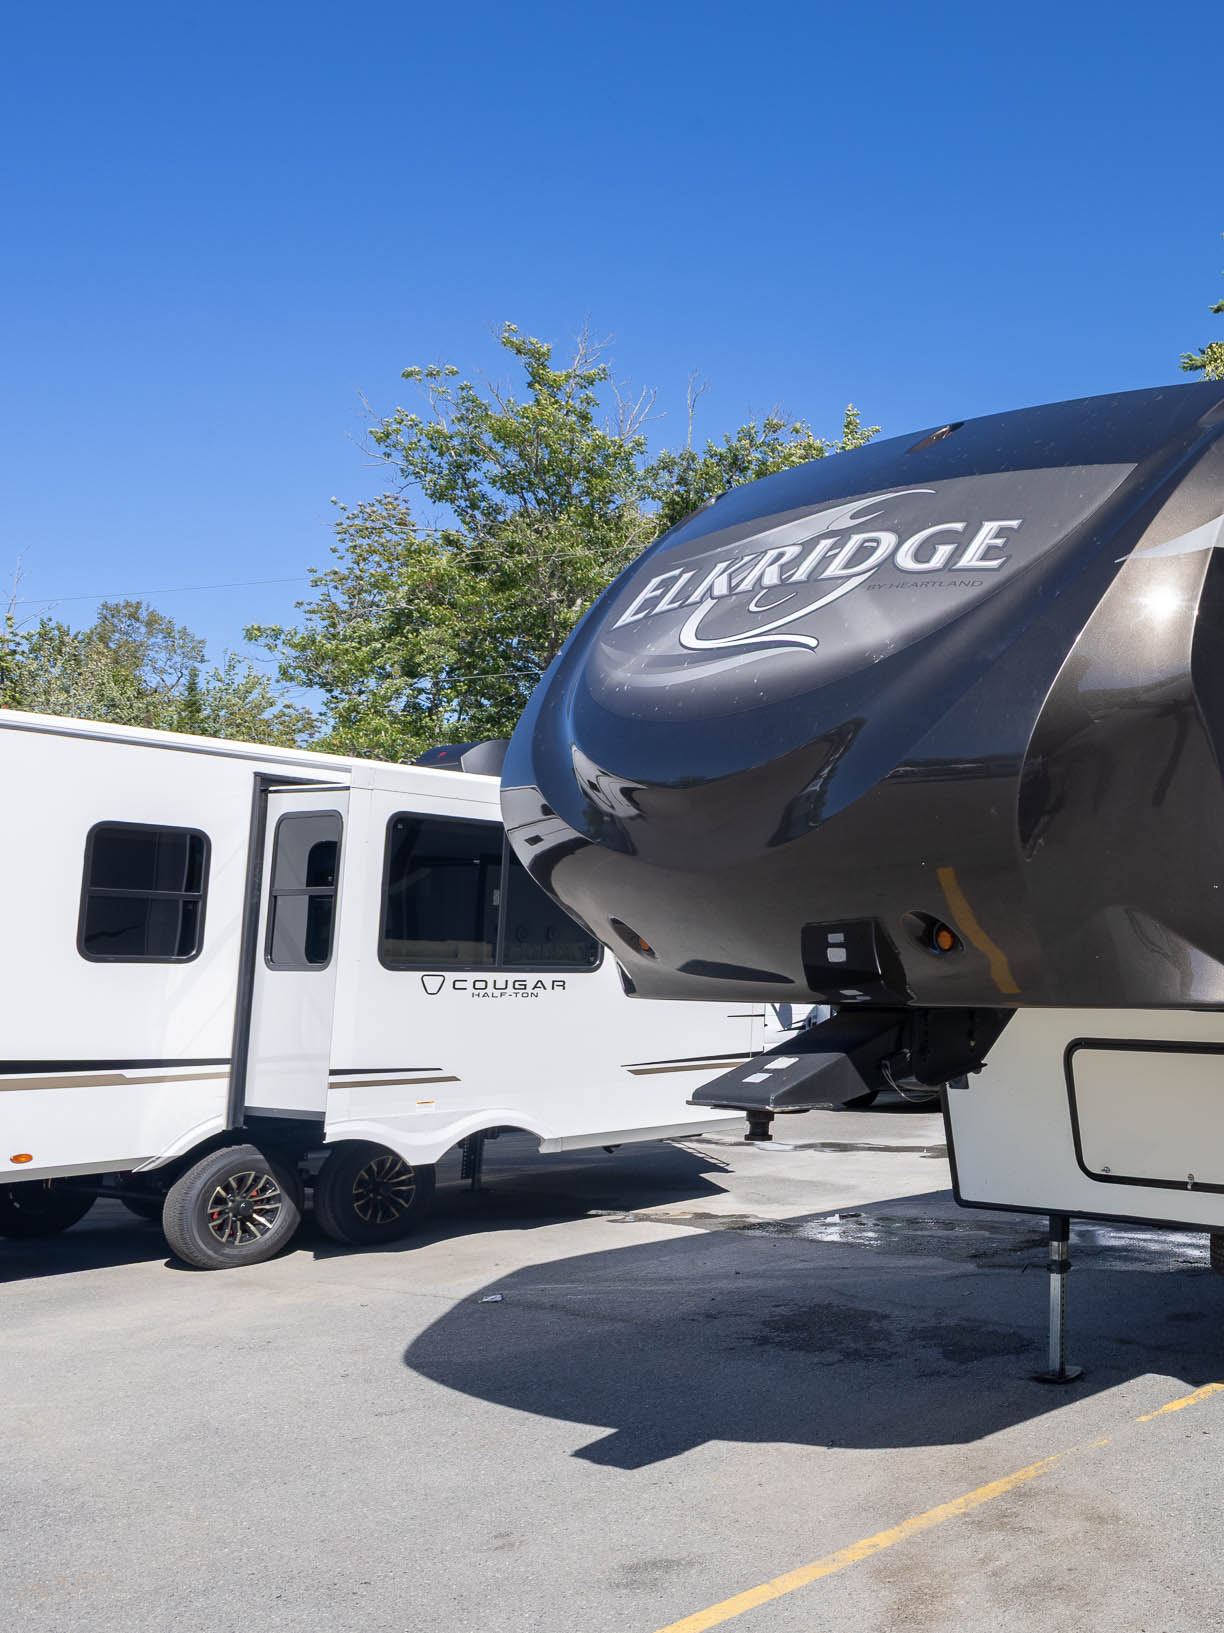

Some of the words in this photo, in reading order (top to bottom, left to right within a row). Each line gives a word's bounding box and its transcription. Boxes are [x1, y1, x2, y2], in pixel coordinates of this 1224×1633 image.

[609, 518, 1024, 633] ELKRIDGE
[888, 578, 984, 590] HEARTLAND
[452, 979, 566, 991] COUGAR
[471, 991, 539, 999] HALF-TON
